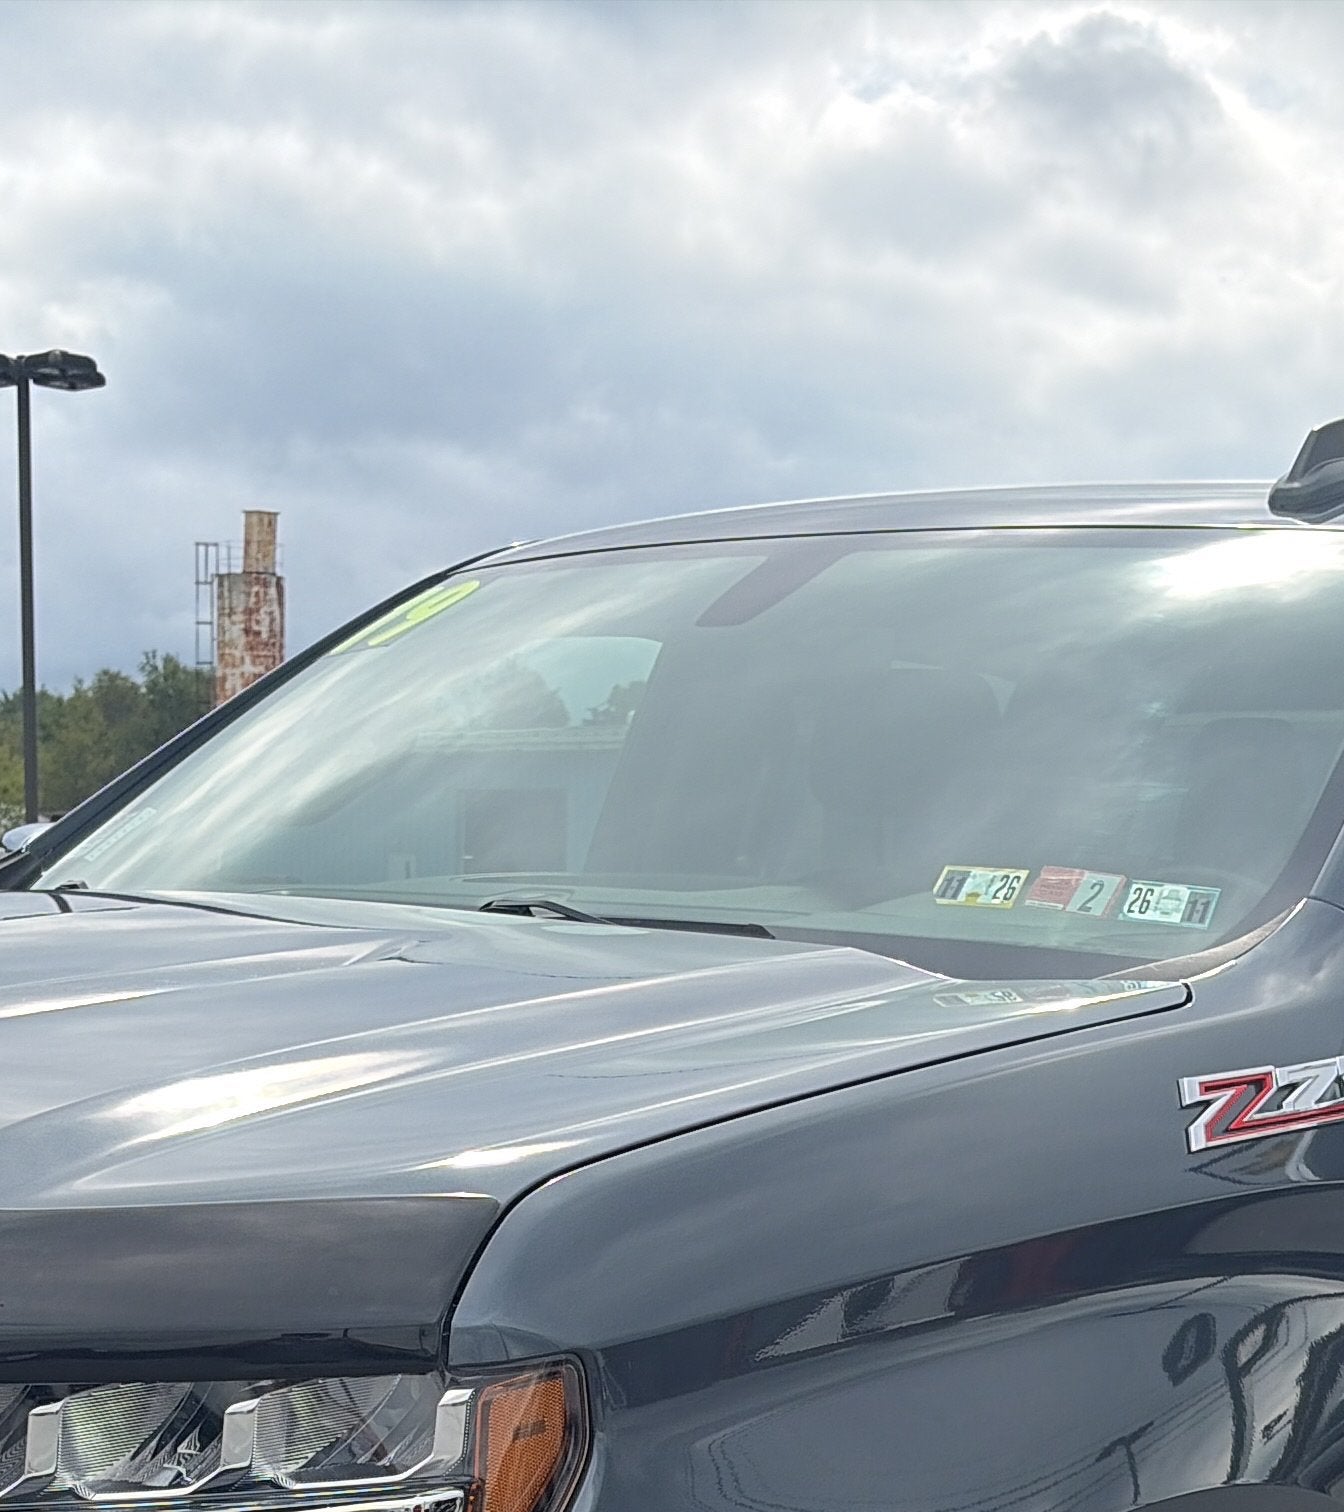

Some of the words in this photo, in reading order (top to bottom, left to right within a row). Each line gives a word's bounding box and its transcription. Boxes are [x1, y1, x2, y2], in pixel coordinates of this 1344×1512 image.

[992, 874, 1021, 901] 26
[1077, 880, 1105, 912] 2
[1127, 887, 1155, 914] 26
